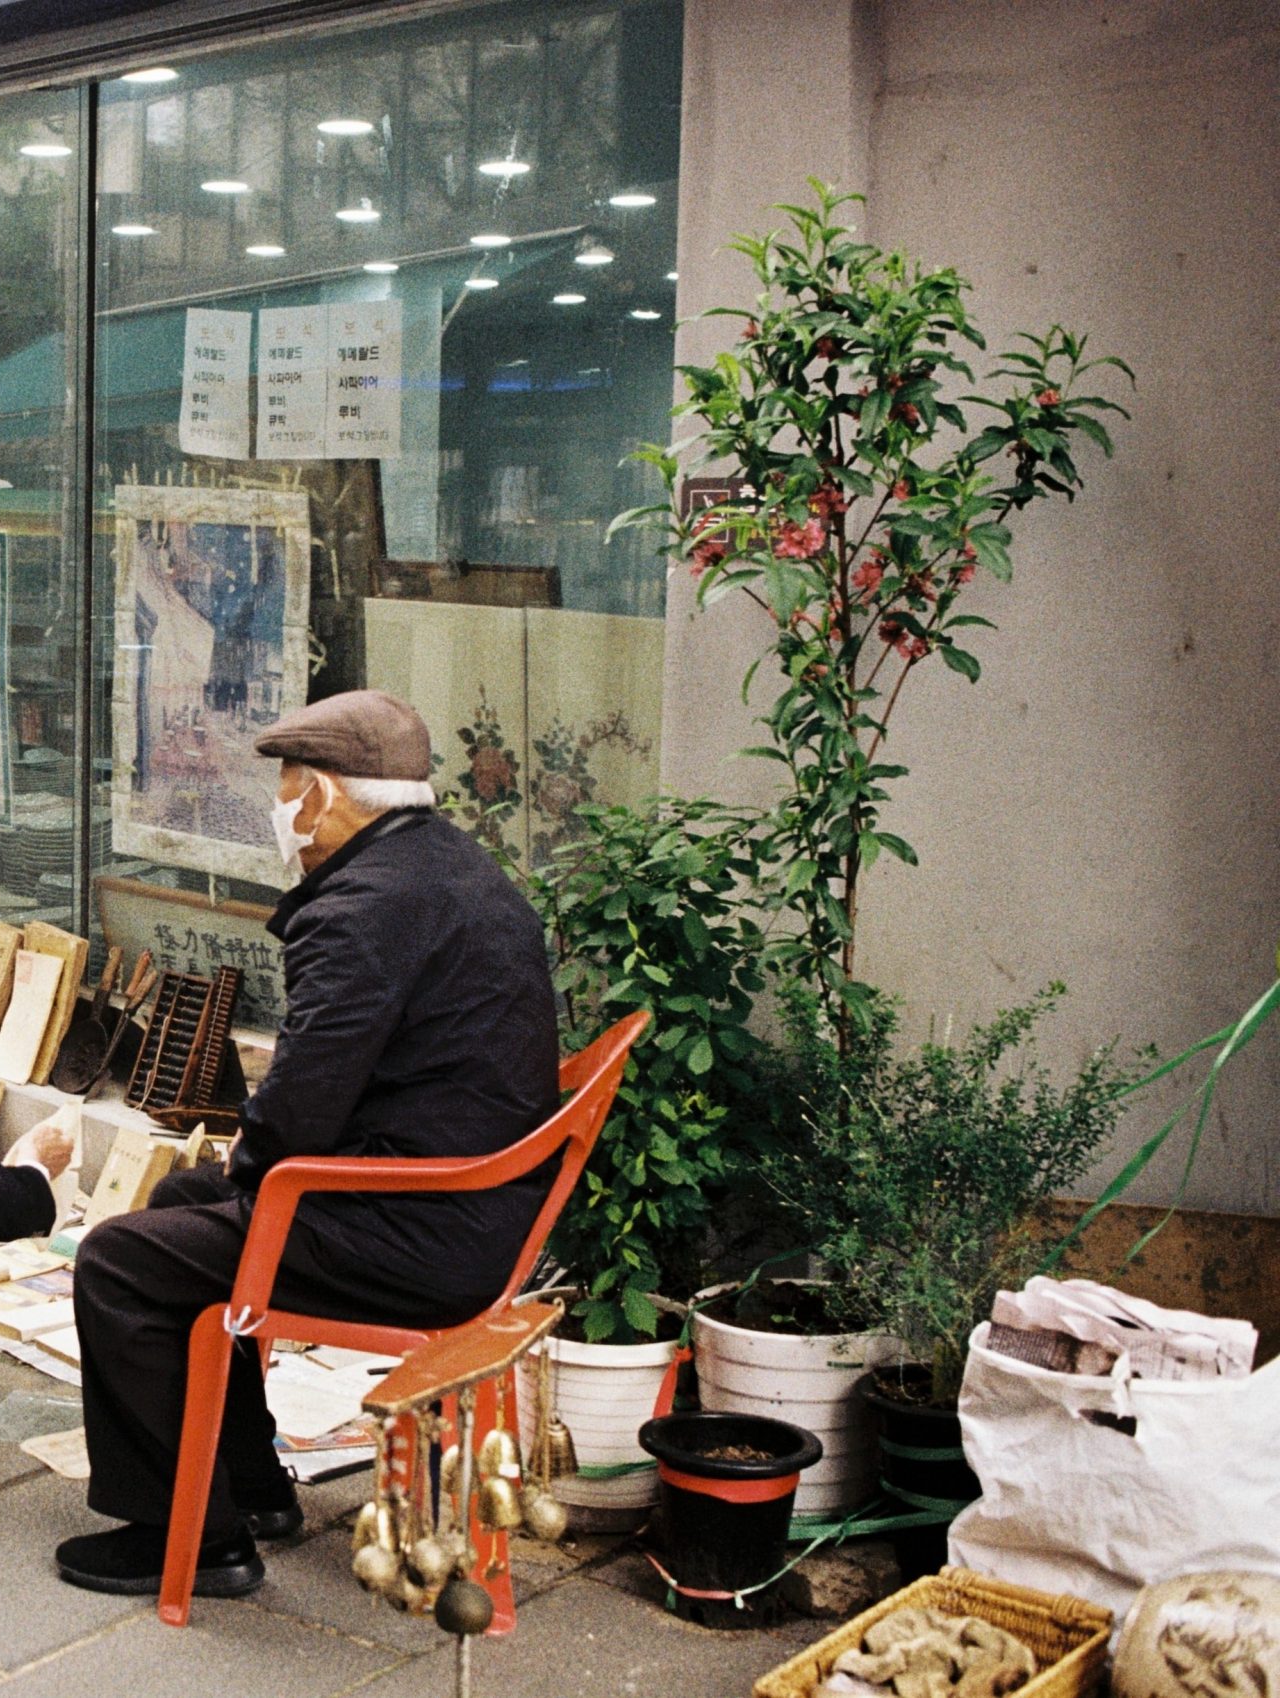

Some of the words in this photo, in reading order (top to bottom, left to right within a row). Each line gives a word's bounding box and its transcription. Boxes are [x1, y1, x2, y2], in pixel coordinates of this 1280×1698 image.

[337, 345, 380, 362] 에메랄드
[267, 371, 303, 386] 사파이어
[338, 375, 379, 391] 사파이어
[338, 404, 361, 420] 루비
